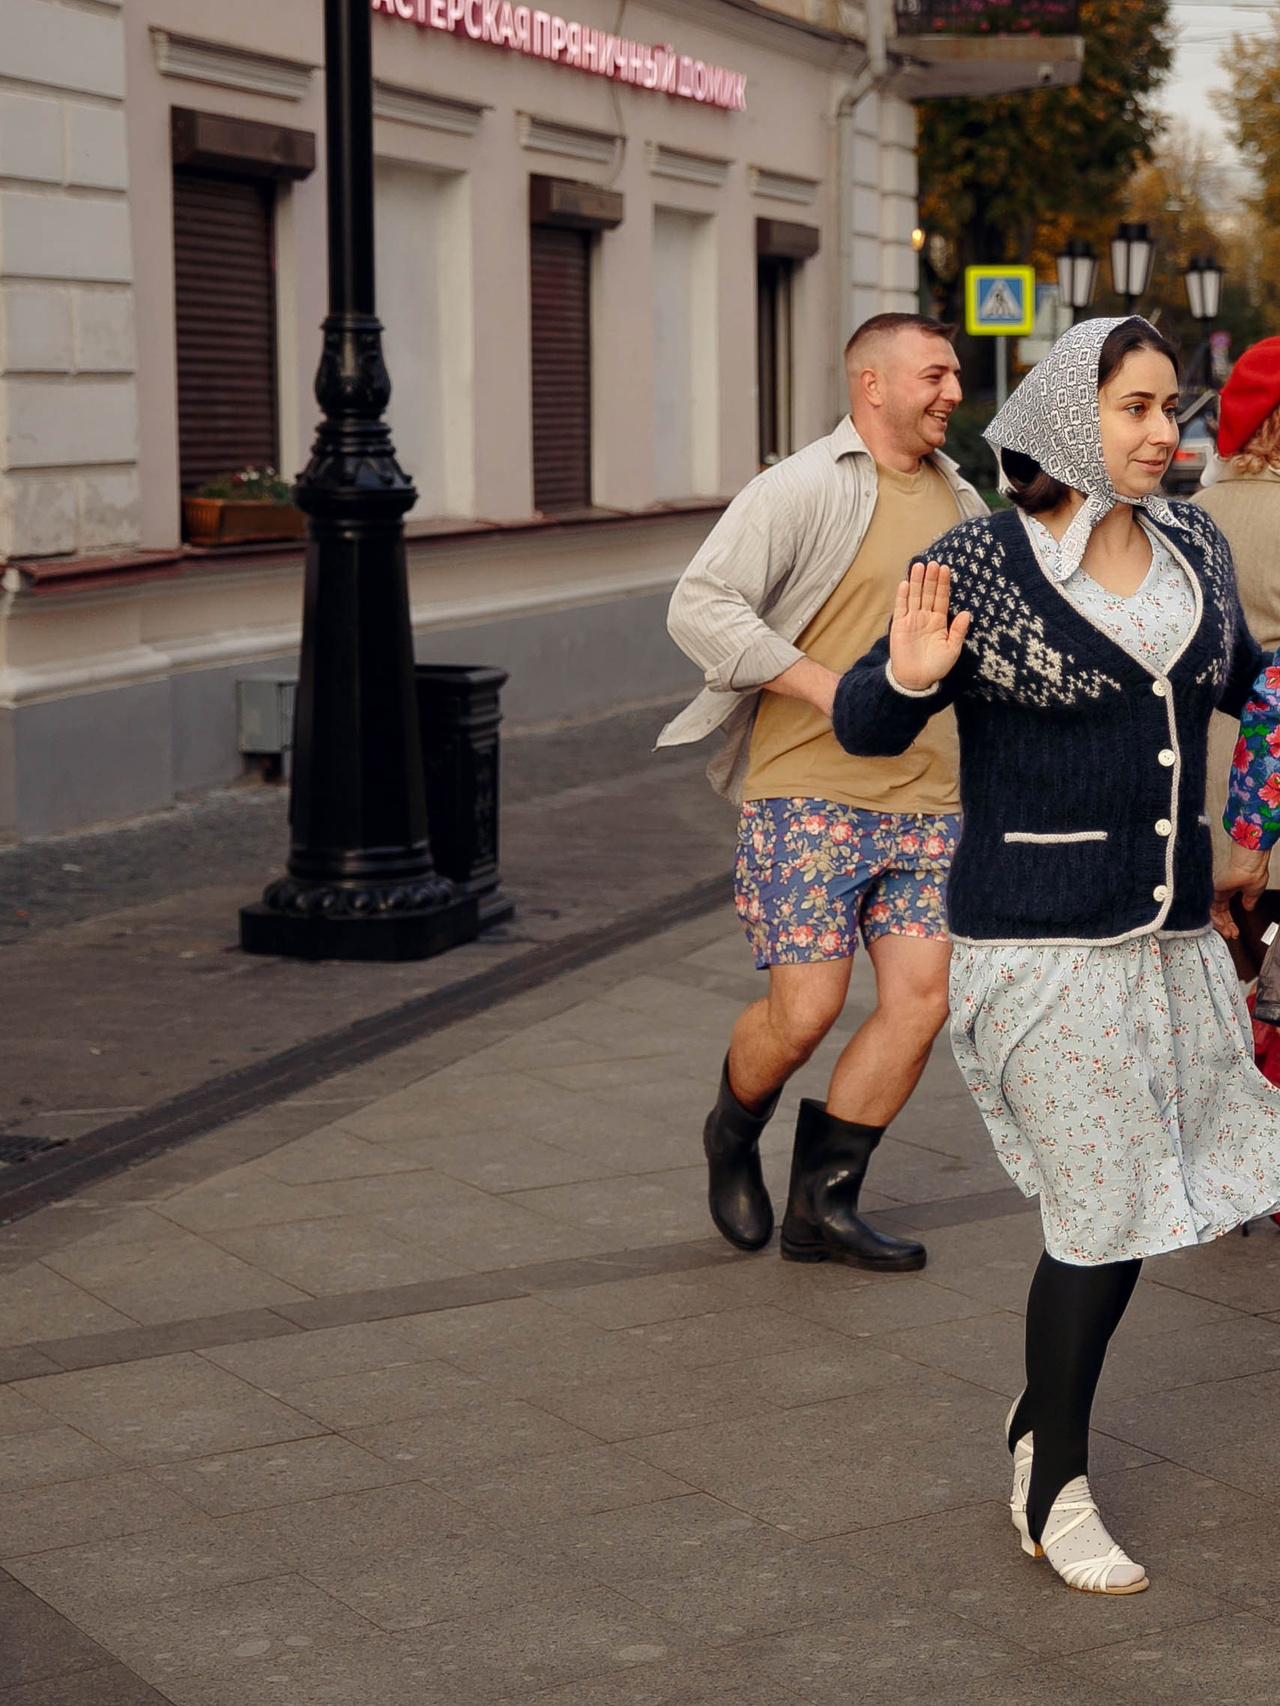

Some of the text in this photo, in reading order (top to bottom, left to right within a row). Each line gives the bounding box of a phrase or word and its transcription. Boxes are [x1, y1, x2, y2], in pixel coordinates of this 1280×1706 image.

[371, 0, 747, 112] ЕРСКАЯ ПРЯНИЧНЫЙ ДОМИК
